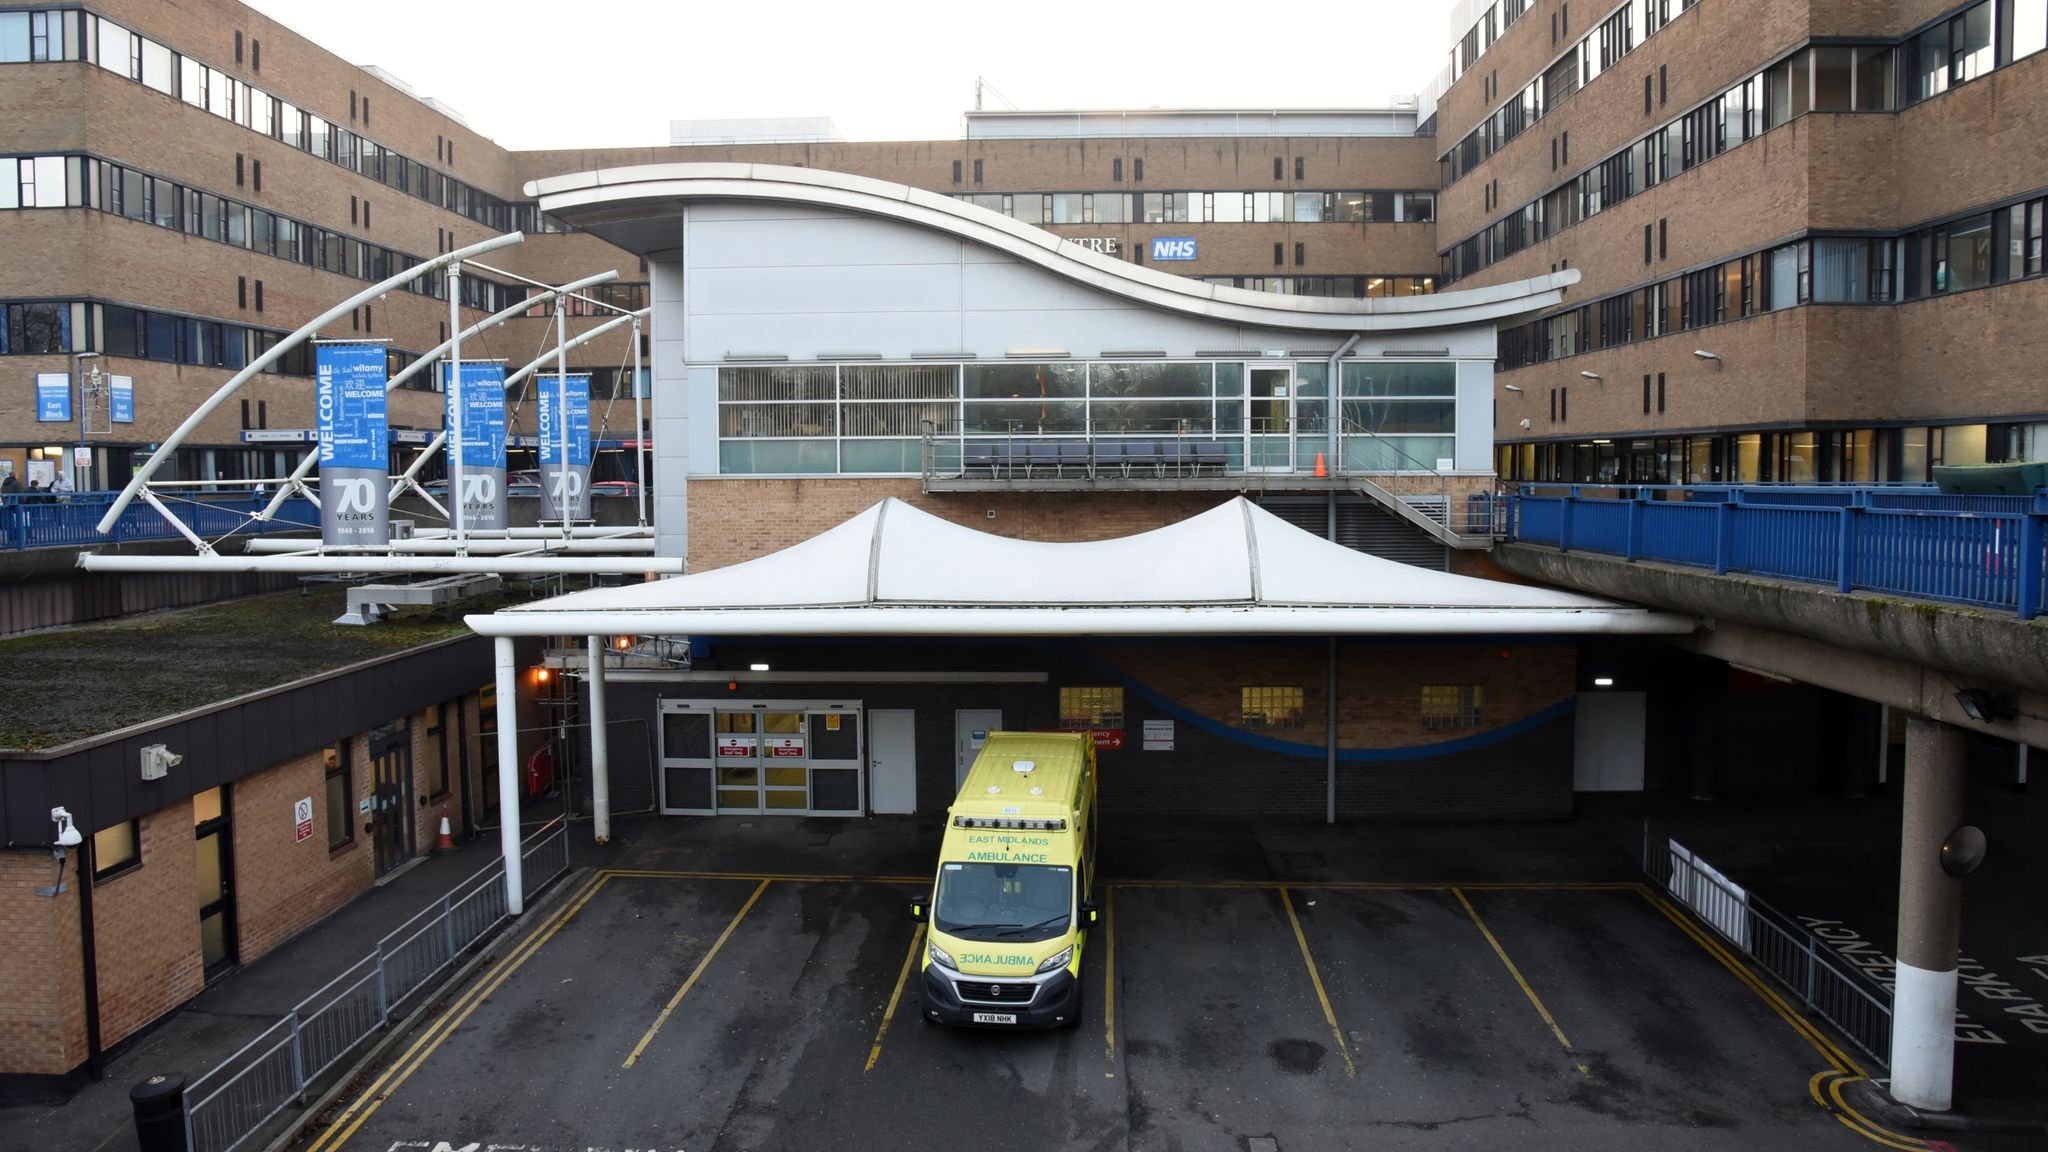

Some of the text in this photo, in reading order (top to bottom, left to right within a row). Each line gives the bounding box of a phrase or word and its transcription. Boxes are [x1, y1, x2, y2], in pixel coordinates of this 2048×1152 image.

[1154, 241, 1195, 257] NHS
[353, 364, 384, 373] witamy
[344, 390, 385, 398] WELCOME
[319, 364, 335, 462] WELCOME
[540, 391, 551, 460] WELCOME
[463, 474, 496, 503] 70
[332, 477, 376, 513] 70
[336, 513, 375, 521] YEARS
[968, 835, 1049, 846] EAST MIDLANDS
[967, 852, 1048, 863] AMBULANCE
[978, 1014, 1012, 1023] YX18 NHK
